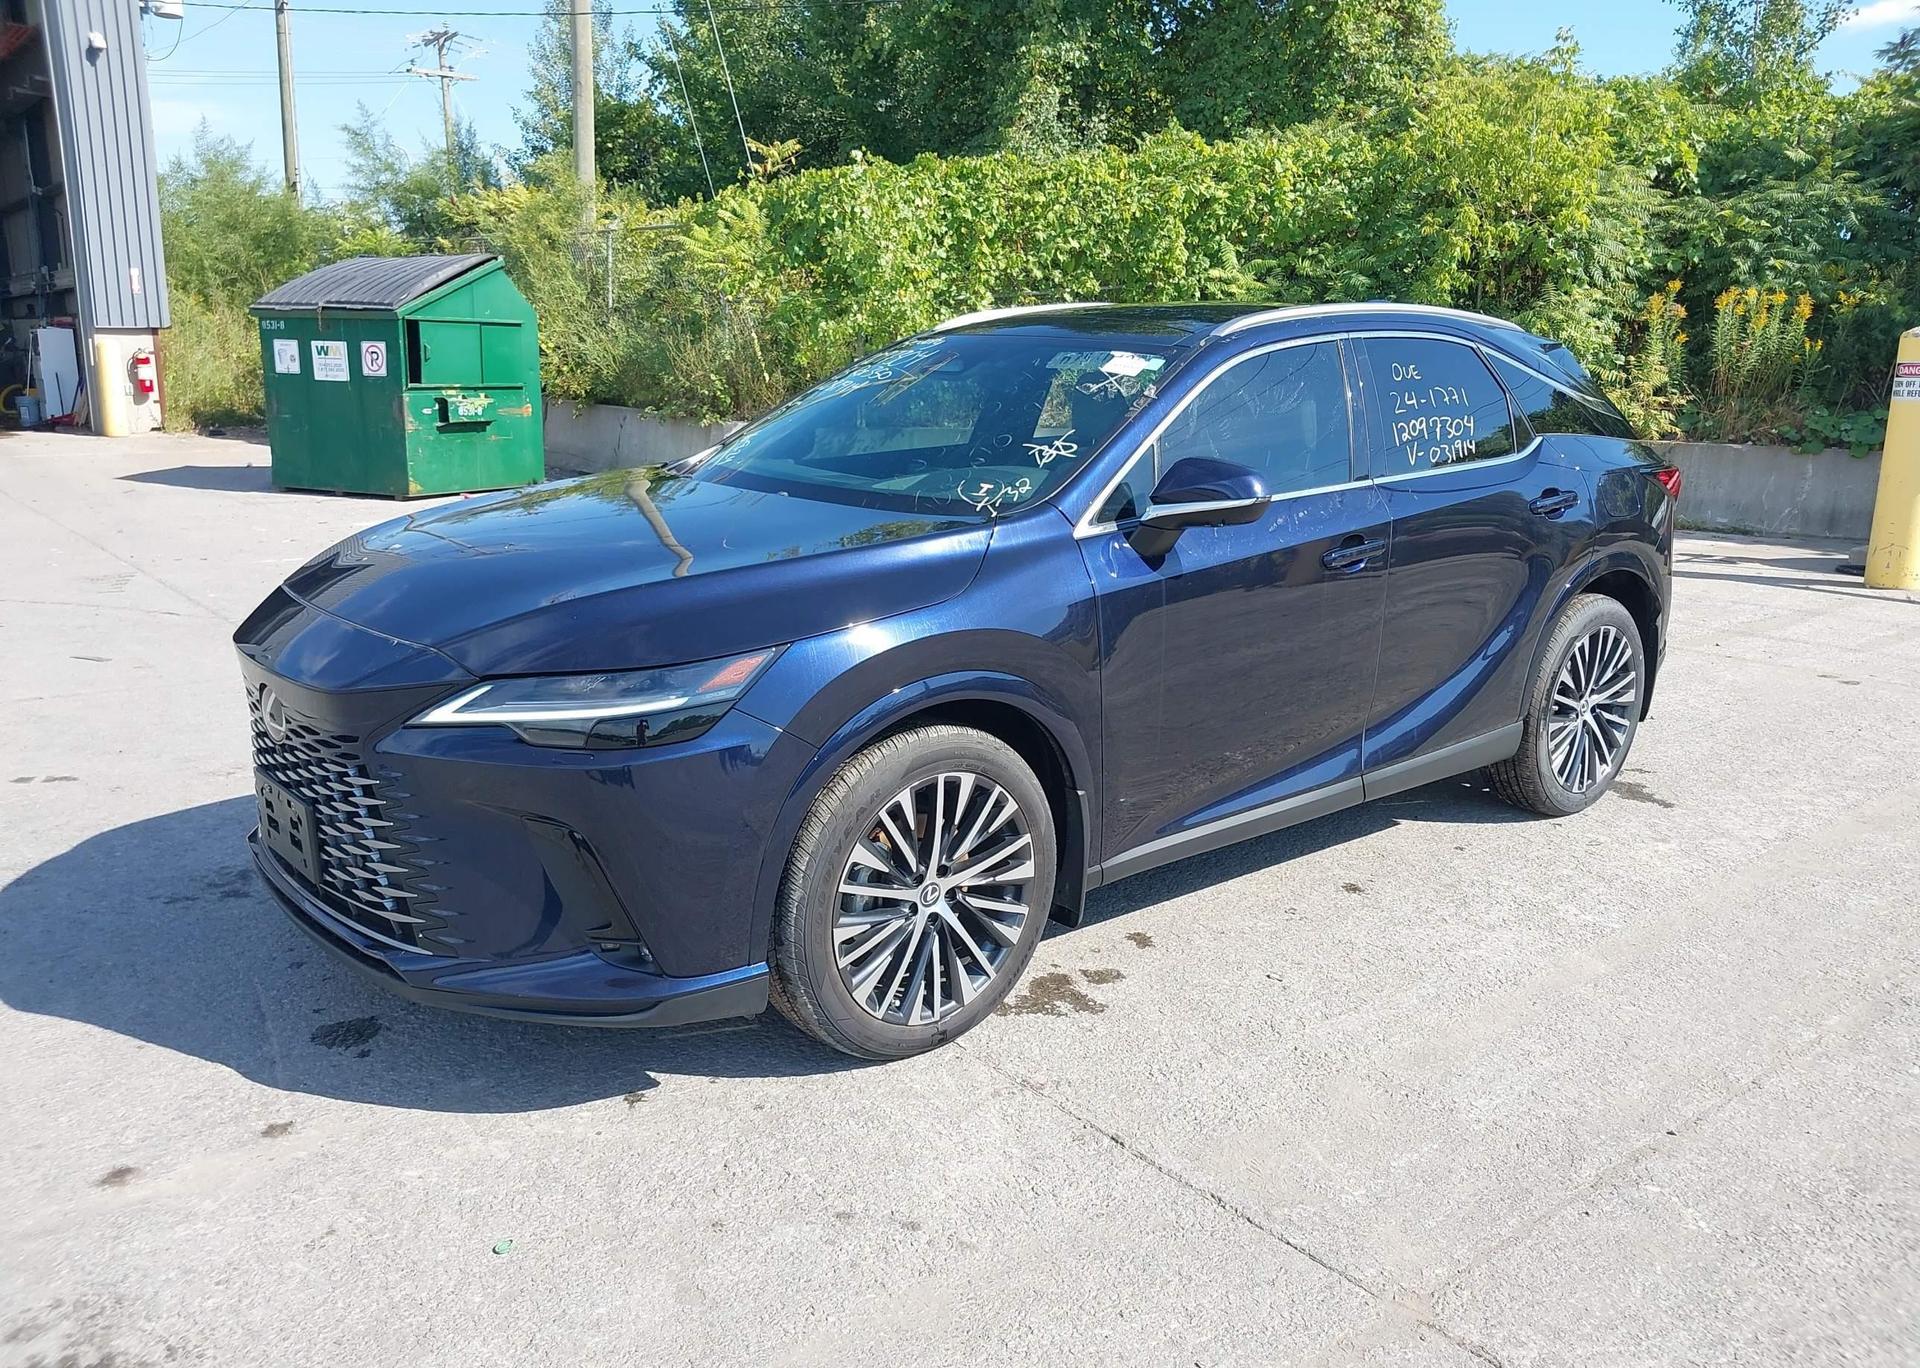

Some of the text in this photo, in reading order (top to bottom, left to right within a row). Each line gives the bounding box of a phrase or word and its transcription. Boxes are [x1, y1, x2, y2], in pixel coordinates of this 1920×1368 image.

[371, 351, 379, 367] P
[1389, 387, 1470, 414] 24-1771
[1392, 415, 1475, 447] 12097304
